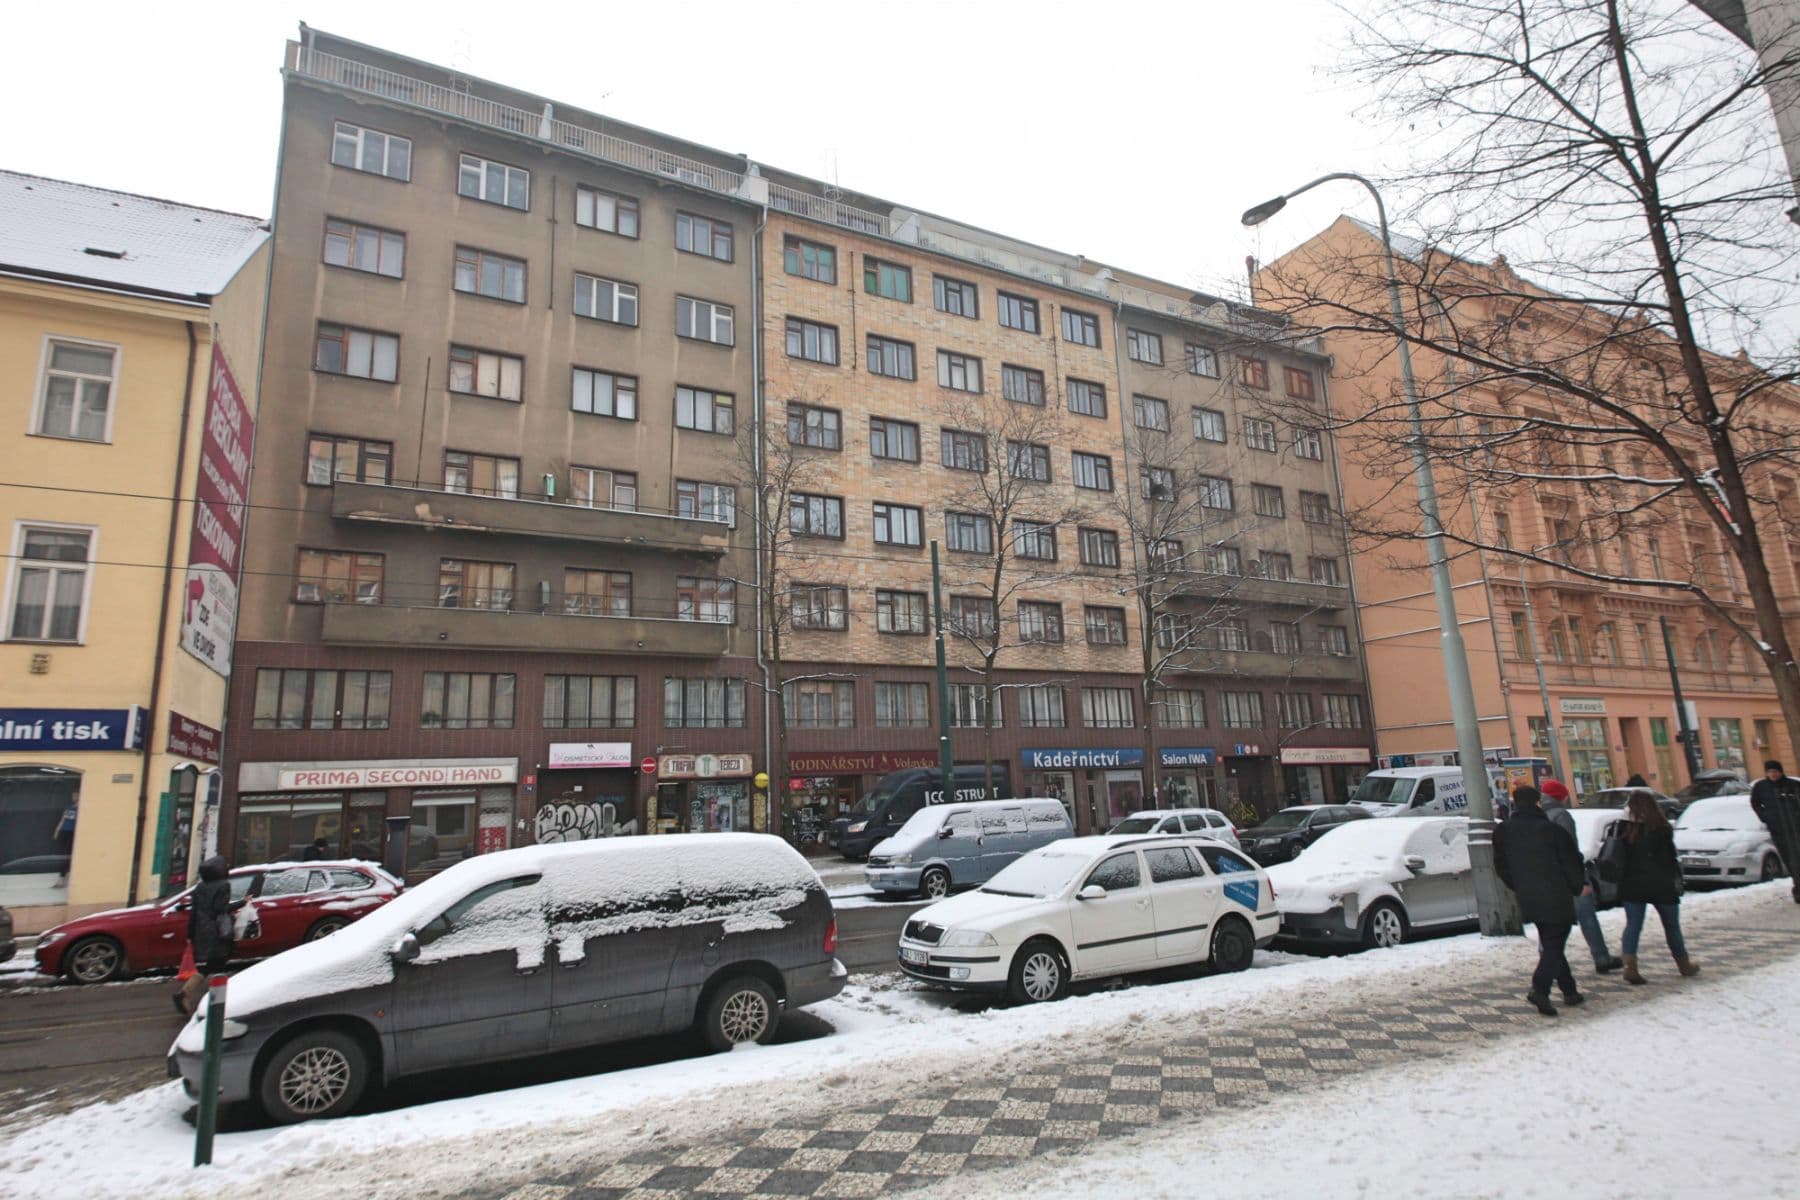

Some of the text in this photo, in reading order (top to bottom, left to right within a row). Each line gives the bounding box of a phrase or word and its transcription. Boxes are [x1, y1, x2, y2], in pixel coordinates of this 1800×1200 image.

[209, 399, 249, 486] REKLAMY
[197, 497, 237, 568] TISKOVINY
[0, 719, 44, 740] lní
[51, 721, 111, 740] tisk
[720, 759, 740, 771] TEREZA
[1033, 750, 1120, 768] Kadeřnictví
[1162, 753, 1208, 765] Salon IWA
[294, 768, 503, 786] PRIMA SECOND HAND
[930, 787, 999, 804] COSTRUT
